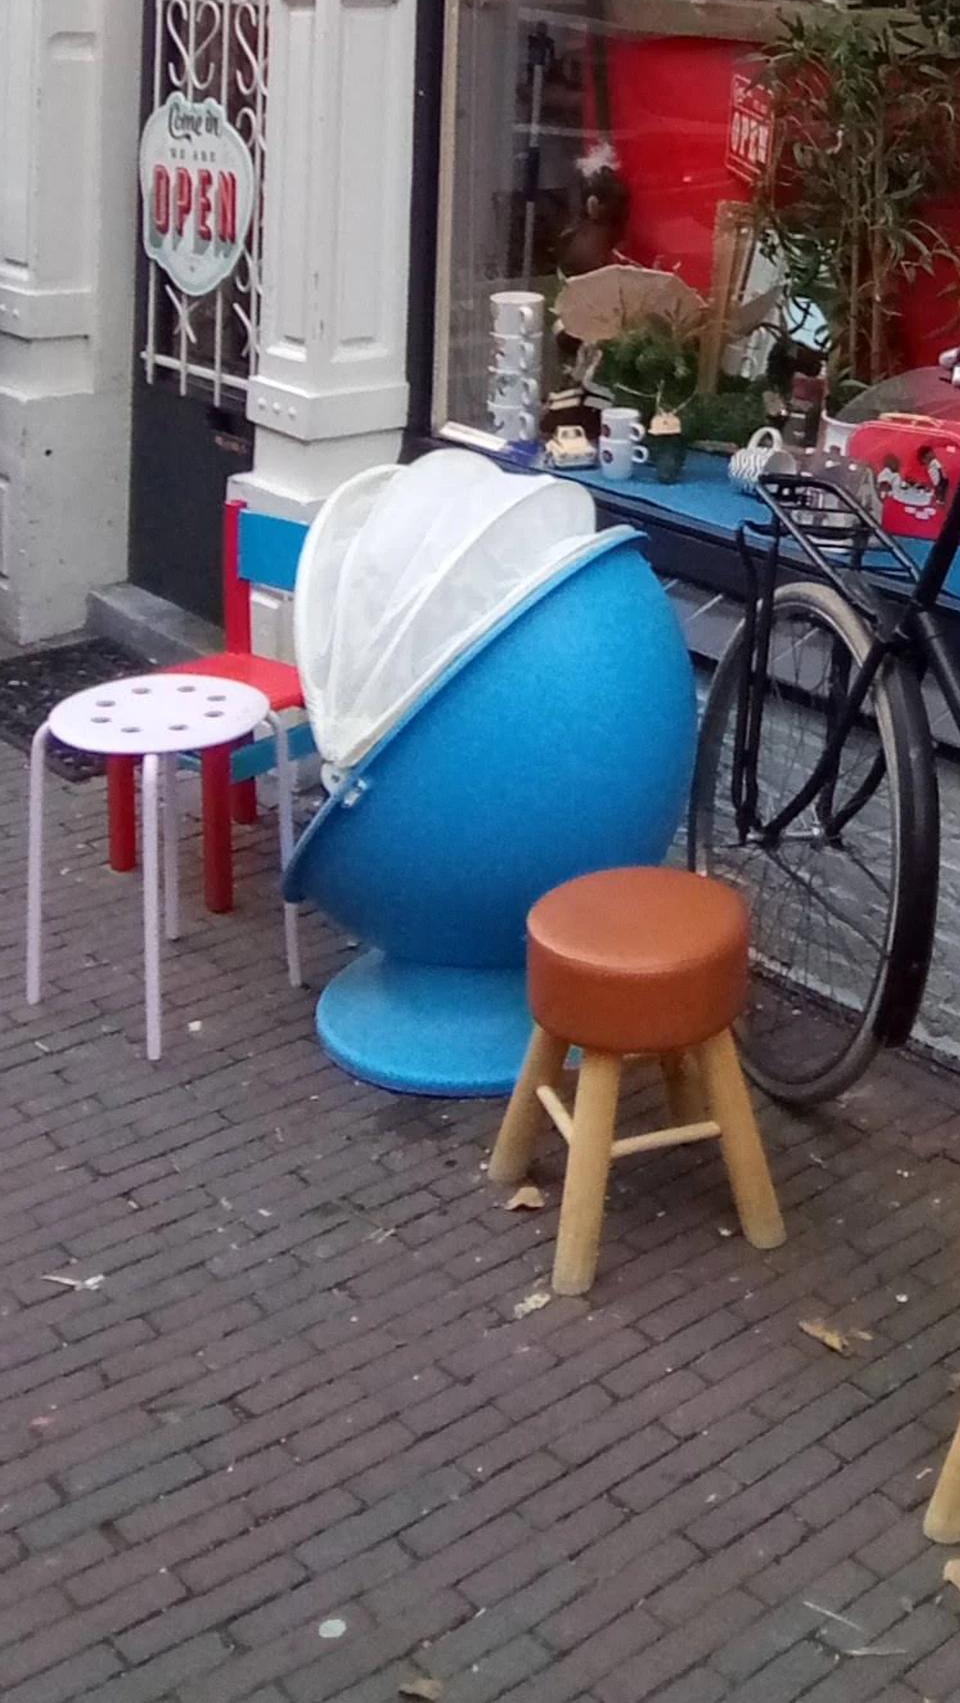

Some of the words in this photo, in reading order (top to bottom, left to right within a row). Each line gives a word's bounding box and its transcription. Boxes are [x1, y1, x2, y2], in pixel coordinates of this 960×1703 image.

[168, 103, 203, 141] Come
[204, 109, 221, 136] in
[152, 163, 237, 246] OPEN
